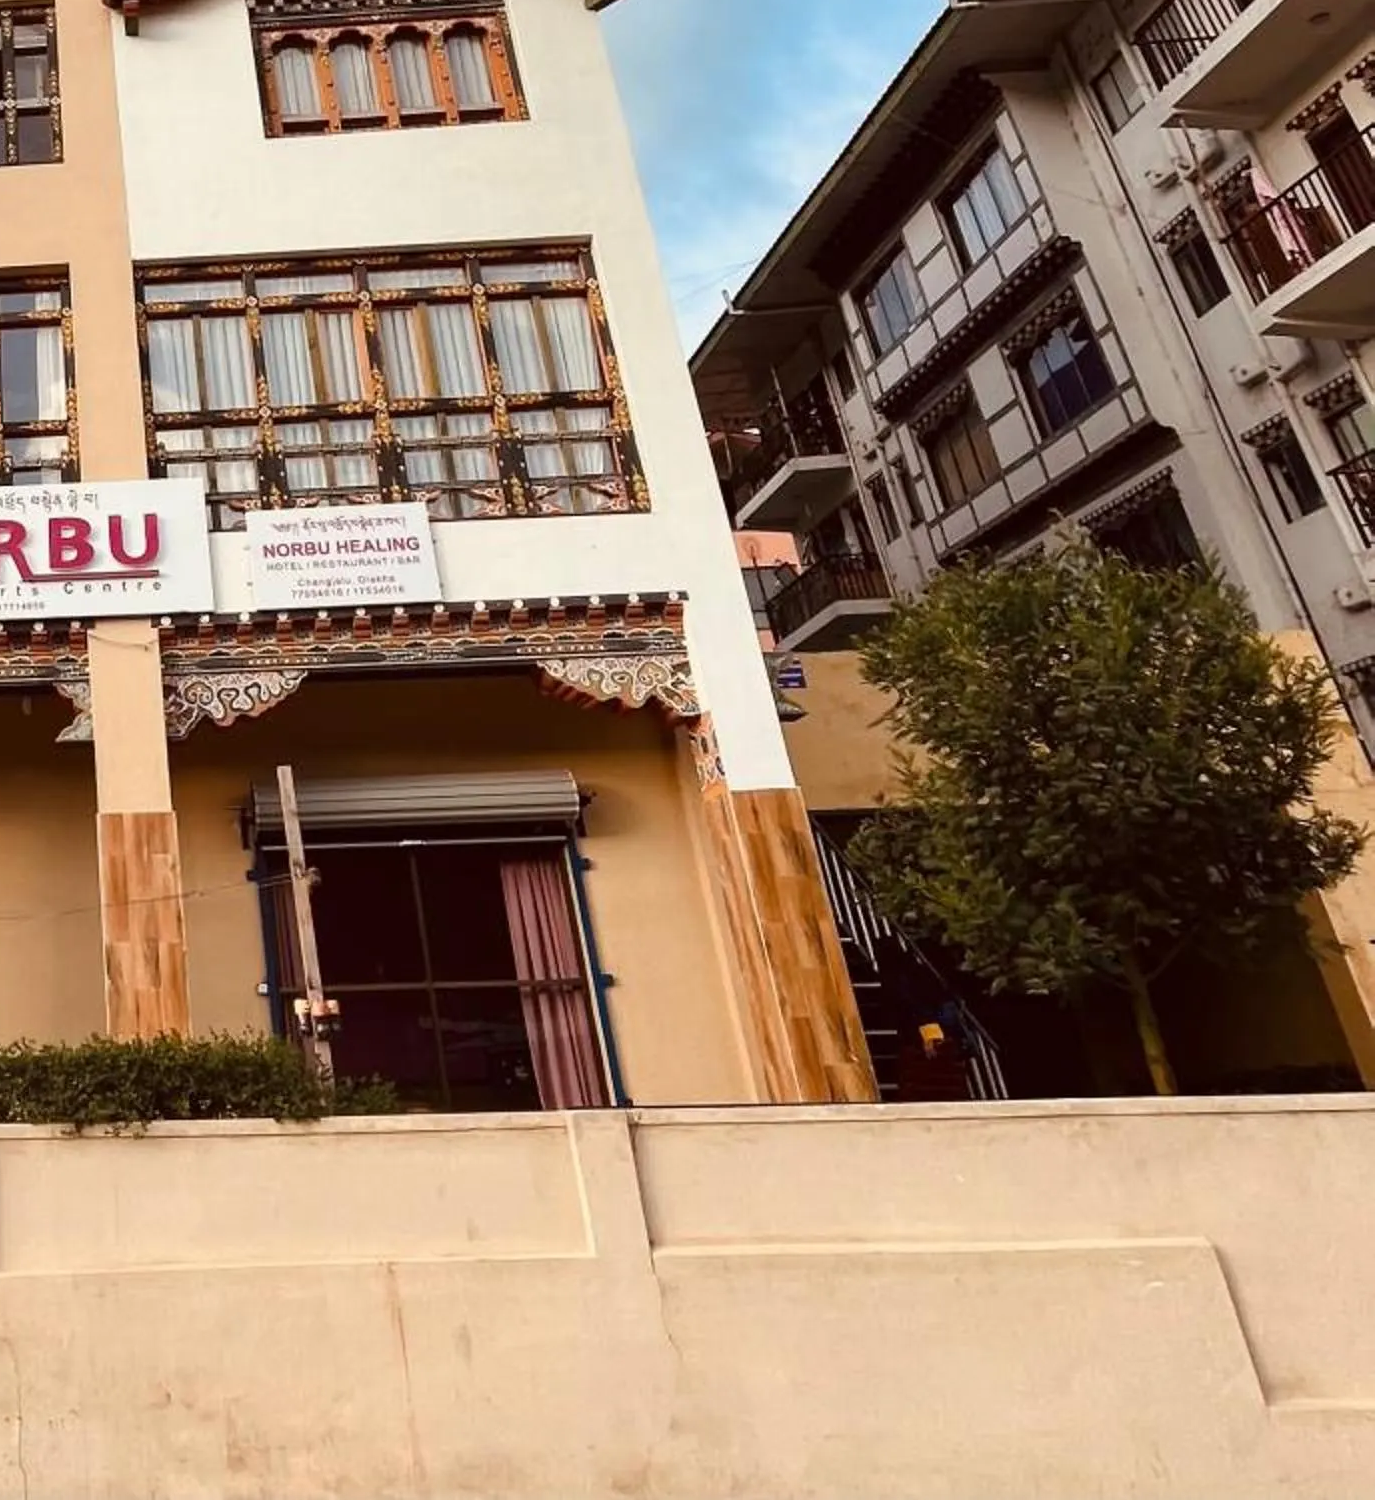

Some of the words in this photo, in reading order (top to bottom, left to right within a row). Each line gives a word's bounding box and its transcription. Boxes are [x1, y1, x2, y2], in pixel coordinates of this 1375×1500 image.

[262, 543, 330, 558] NORBU
[336, 536, 420, 554] HEALING
[266, 562, 304, 571] HOTEL
[312, 557, 388, 569] RESTAURANT
[63, 578, 162, 595] Centre
